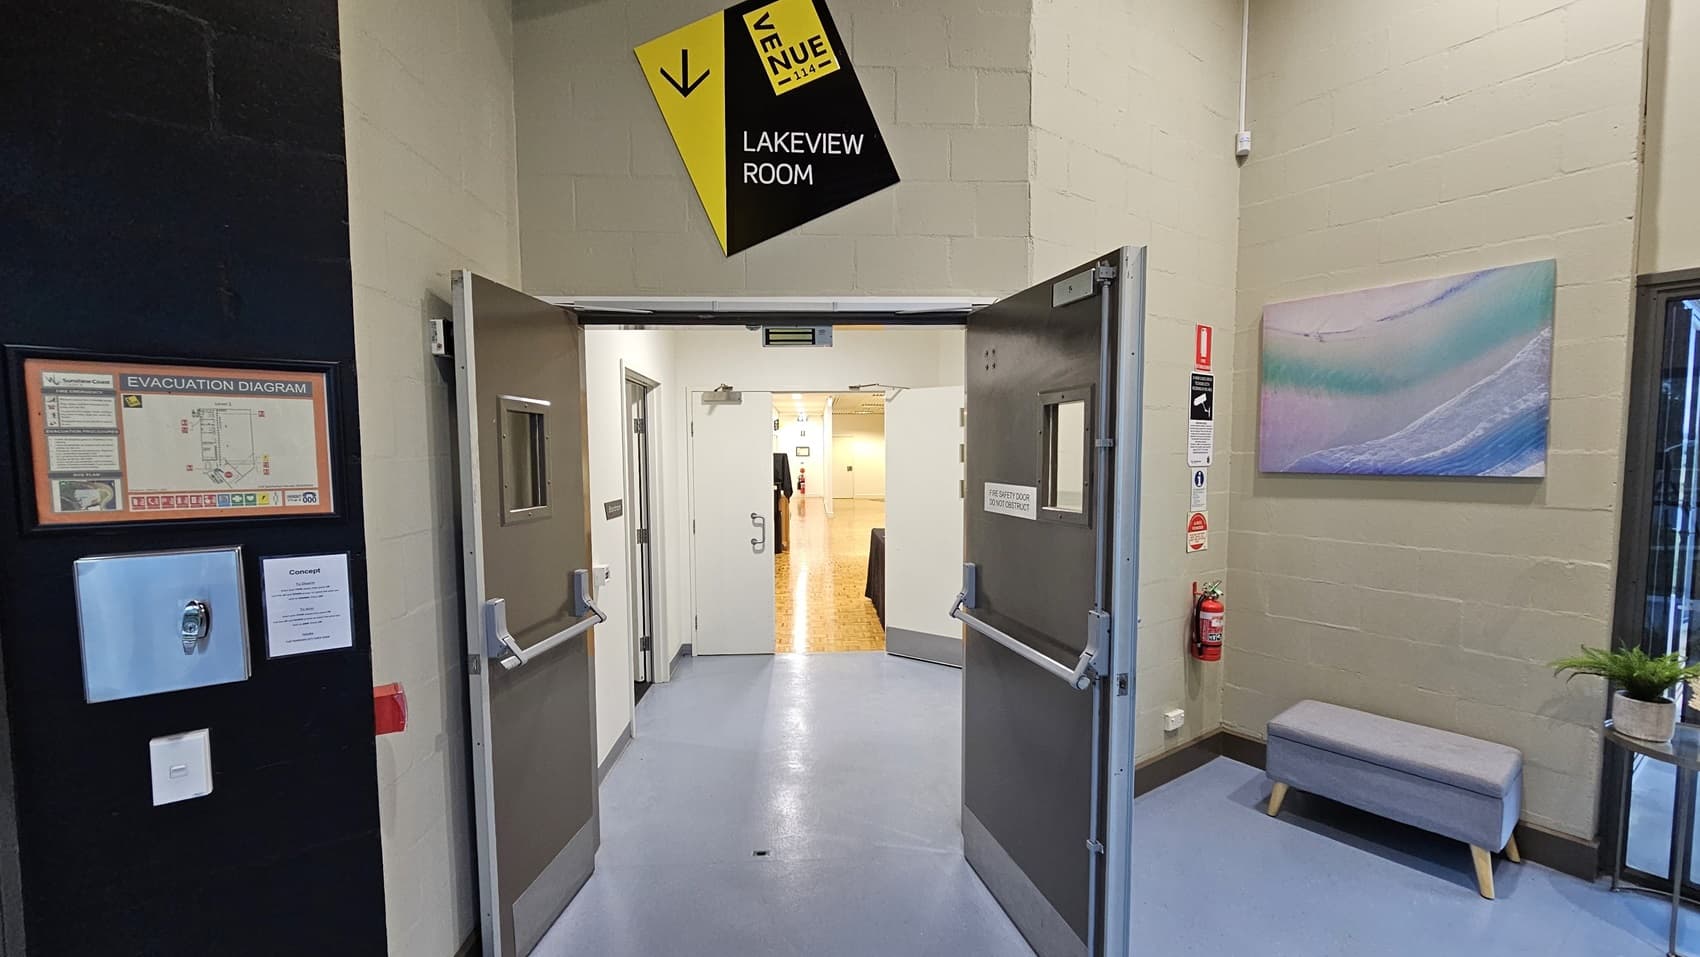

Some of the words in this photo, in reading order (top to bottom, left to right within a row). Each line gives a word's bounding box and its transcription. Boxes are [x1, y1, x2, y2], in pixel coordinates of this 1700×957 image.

[752, 11, 828, 76] VENUE
[793, 65, 816, 81] 114
[742, 130, 865, 155] LAKEVIEW
[742, 162, 814, 186] ROOM
[127, 376, 234, 391] EVACUATION
[238, 381, 307, 393] DIAGRAM
[302, 496, 317, 504] 000
[989, 489, 998, 497] FIRE
[999, 490, 1016, 500] SAFETY
[1016, 492, 1030, 501] DOOR
[989, 498, 996, 506] DO
[996, 499, 1005, 507] NOT
[1005, 500, 1030, 512] OBSTRUCT
[288, 568, 321, 576] Concept
